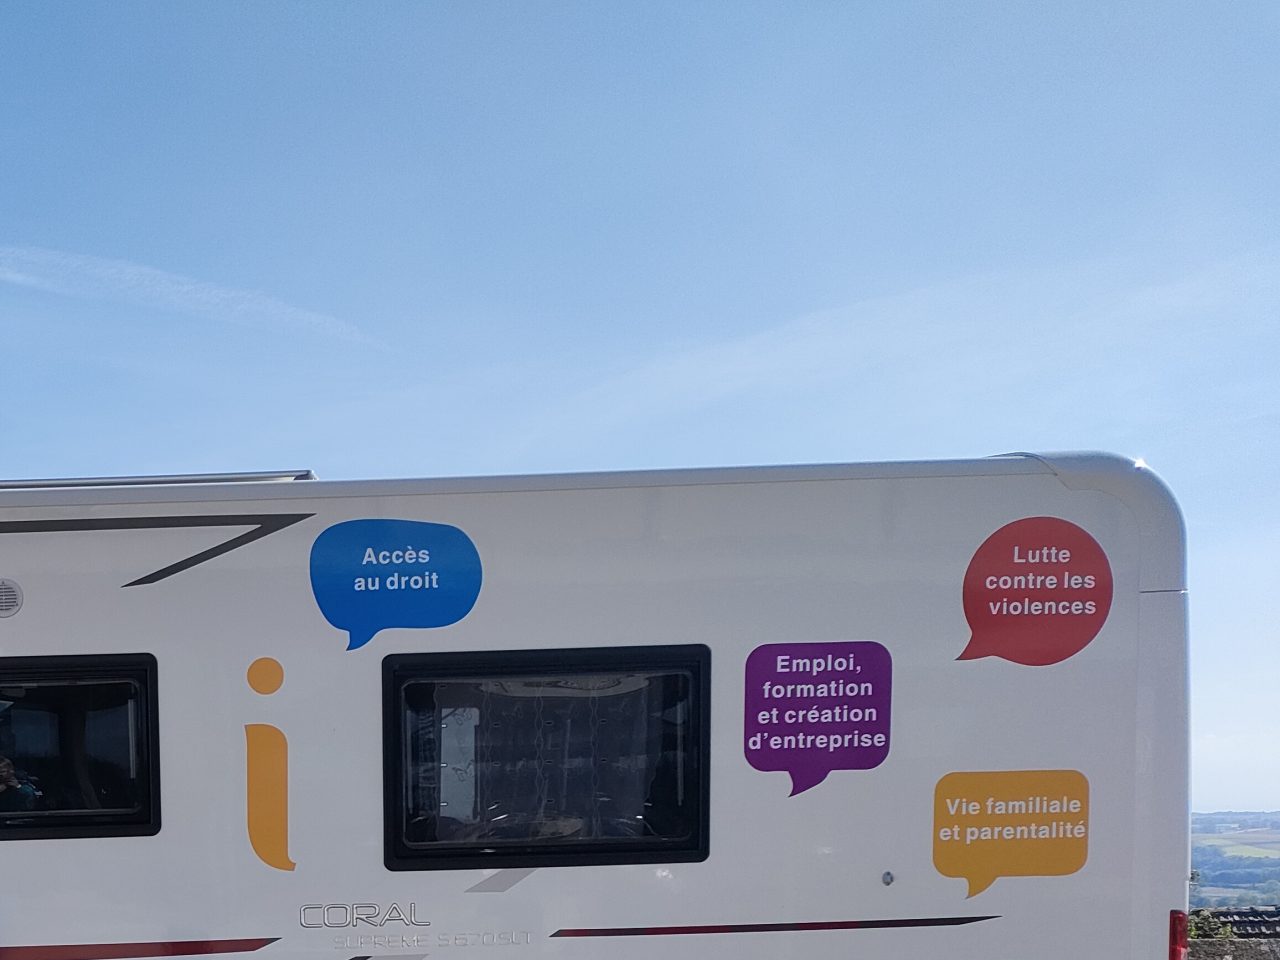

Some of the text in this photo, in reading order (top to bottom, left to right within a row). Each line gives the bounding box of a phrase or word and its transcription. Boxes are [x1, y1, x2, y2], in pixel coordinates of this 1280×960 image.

[361, 545, 430, 565] Accès
[1013, 546, 1071, 564] Lutte
[354, 571, 439, 591] au droit
[985, 571, 1096, 590] contre les
[989, 597, 1096, 615] violences
[776, 653, 861, 676] Emploi,
[762, 679, 873, 699] formation
[757, 704, 877, 725] et création
[748, 731, 887, 752] d’entreprise
[945, 796, 1081, 816] Vie familiale
[939, 820, 1086, 845] et parentalité
[299, 903, 431, 928] CORAL
